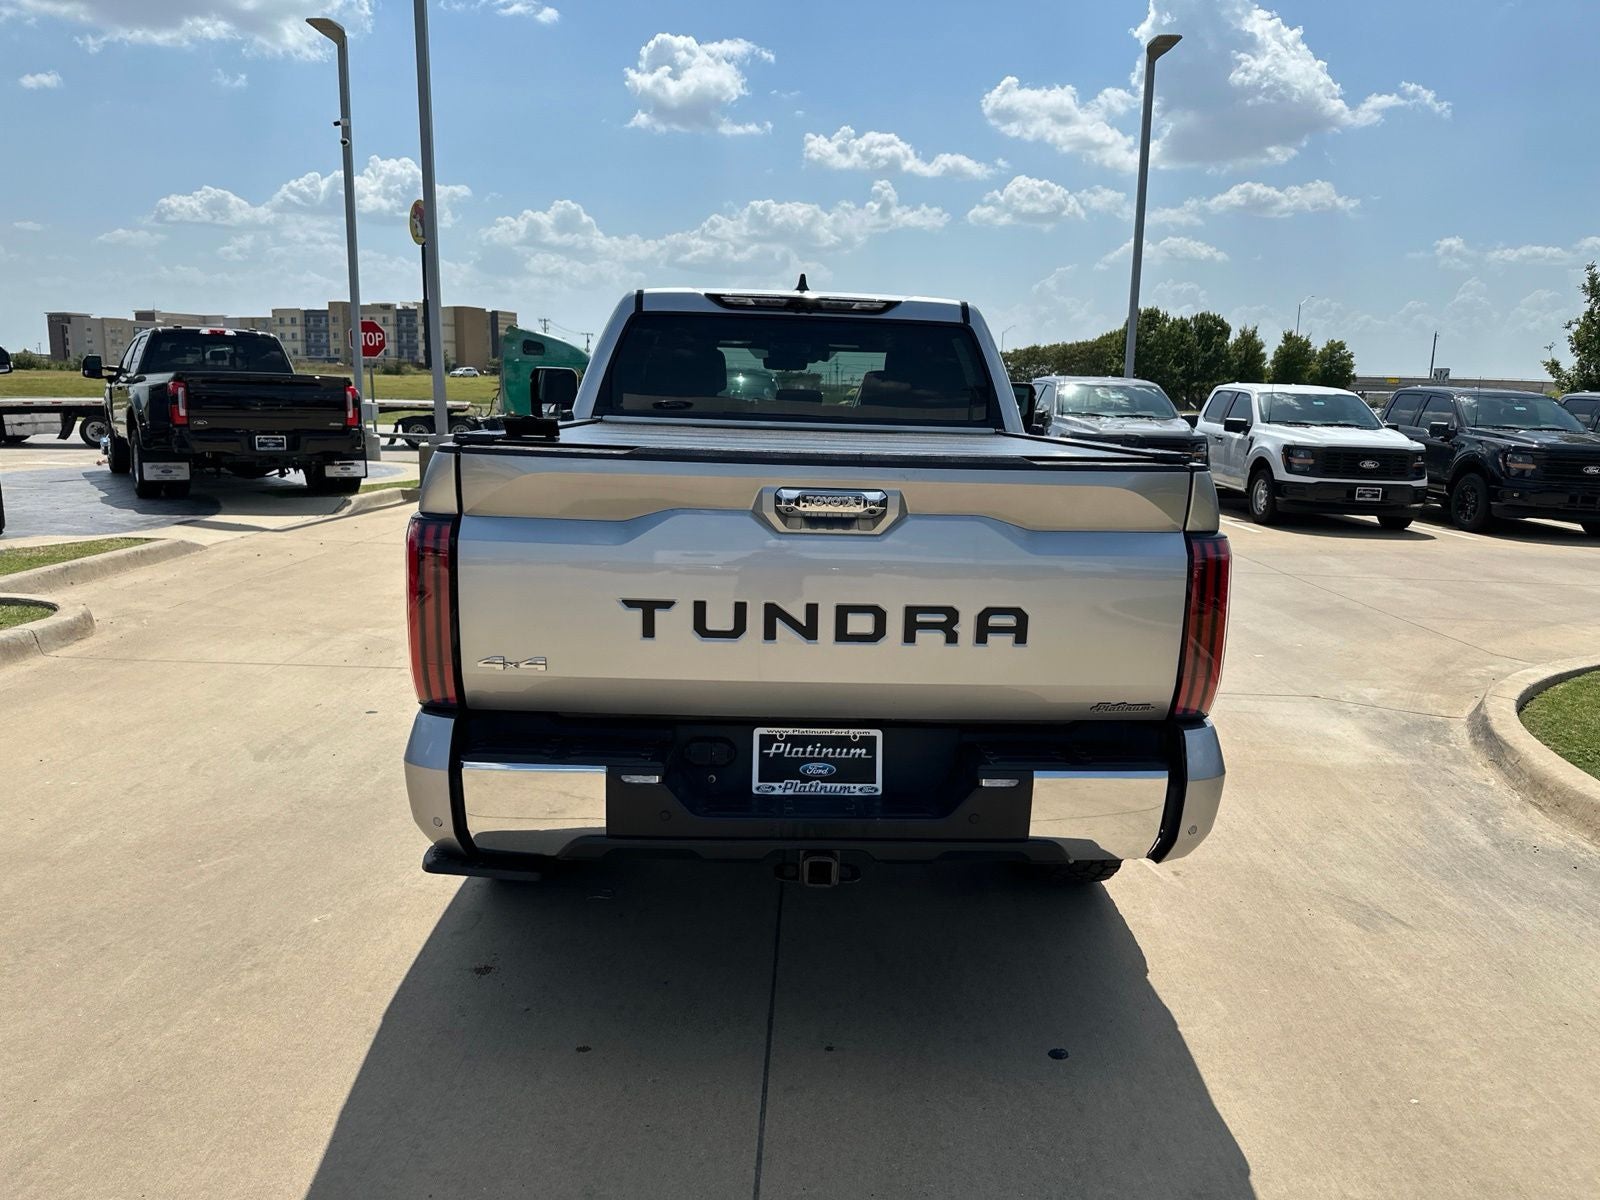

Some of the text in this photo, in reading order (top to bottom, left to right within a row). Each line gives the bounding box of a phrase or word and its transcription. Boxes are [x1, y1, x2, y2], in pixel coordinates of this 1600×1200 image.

[361, 332, 384, 346] TOP
[806, 495, 857, 507] TOYOTA
[620, 598, 1030, 646] TUNDRA
[477, 655, 547, 671] 4x4
[1089, 702, 1155, 713] Platinum
[763, 742, 872, 758] Platinum
[805, 765, 830, 775] Ford
[781, 781, 857, 794] Platinum
